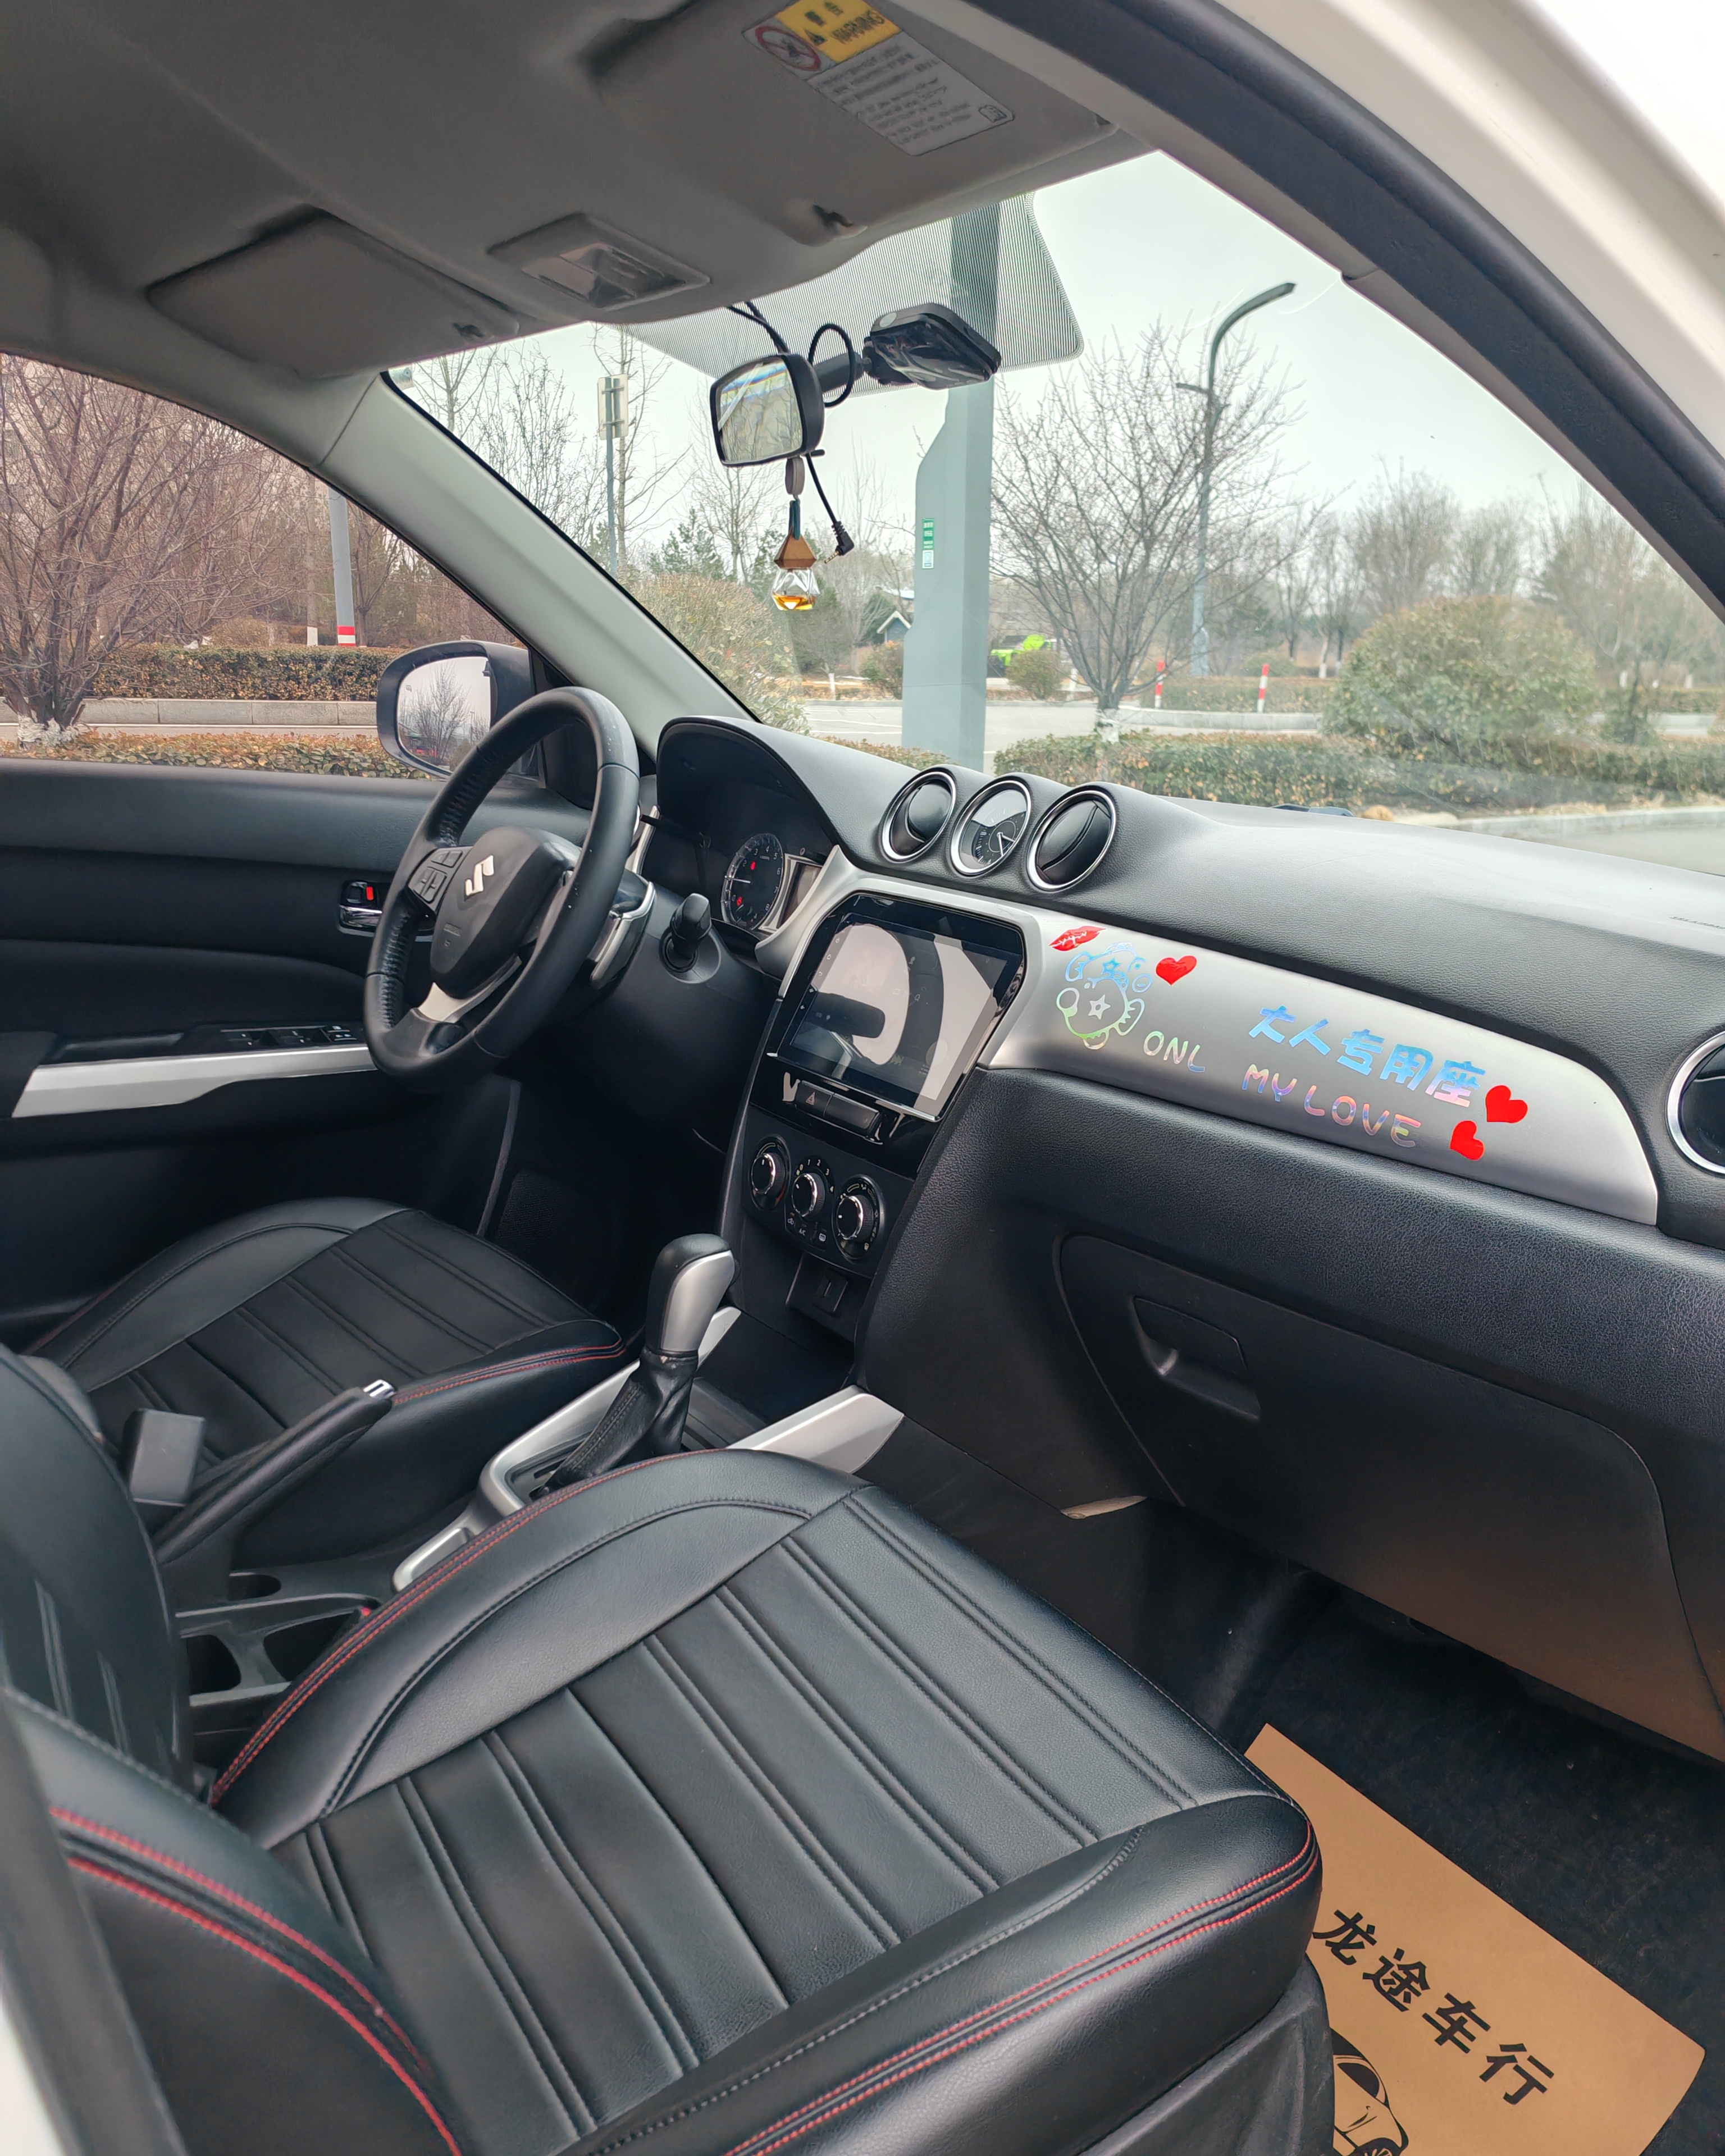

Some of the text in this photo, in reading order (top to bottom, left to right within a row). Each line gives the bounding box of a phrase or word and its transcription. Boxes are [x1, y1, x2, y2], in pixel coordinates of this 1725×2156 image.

[1143, 1030, 1206, 1073] ONL
[1248, 1005, 1486, 1108] 大人专用座
[1242, 1063, 1422, 1148] MY LOVE
[1312, 1909, 1555, 2105] 龙途车行
